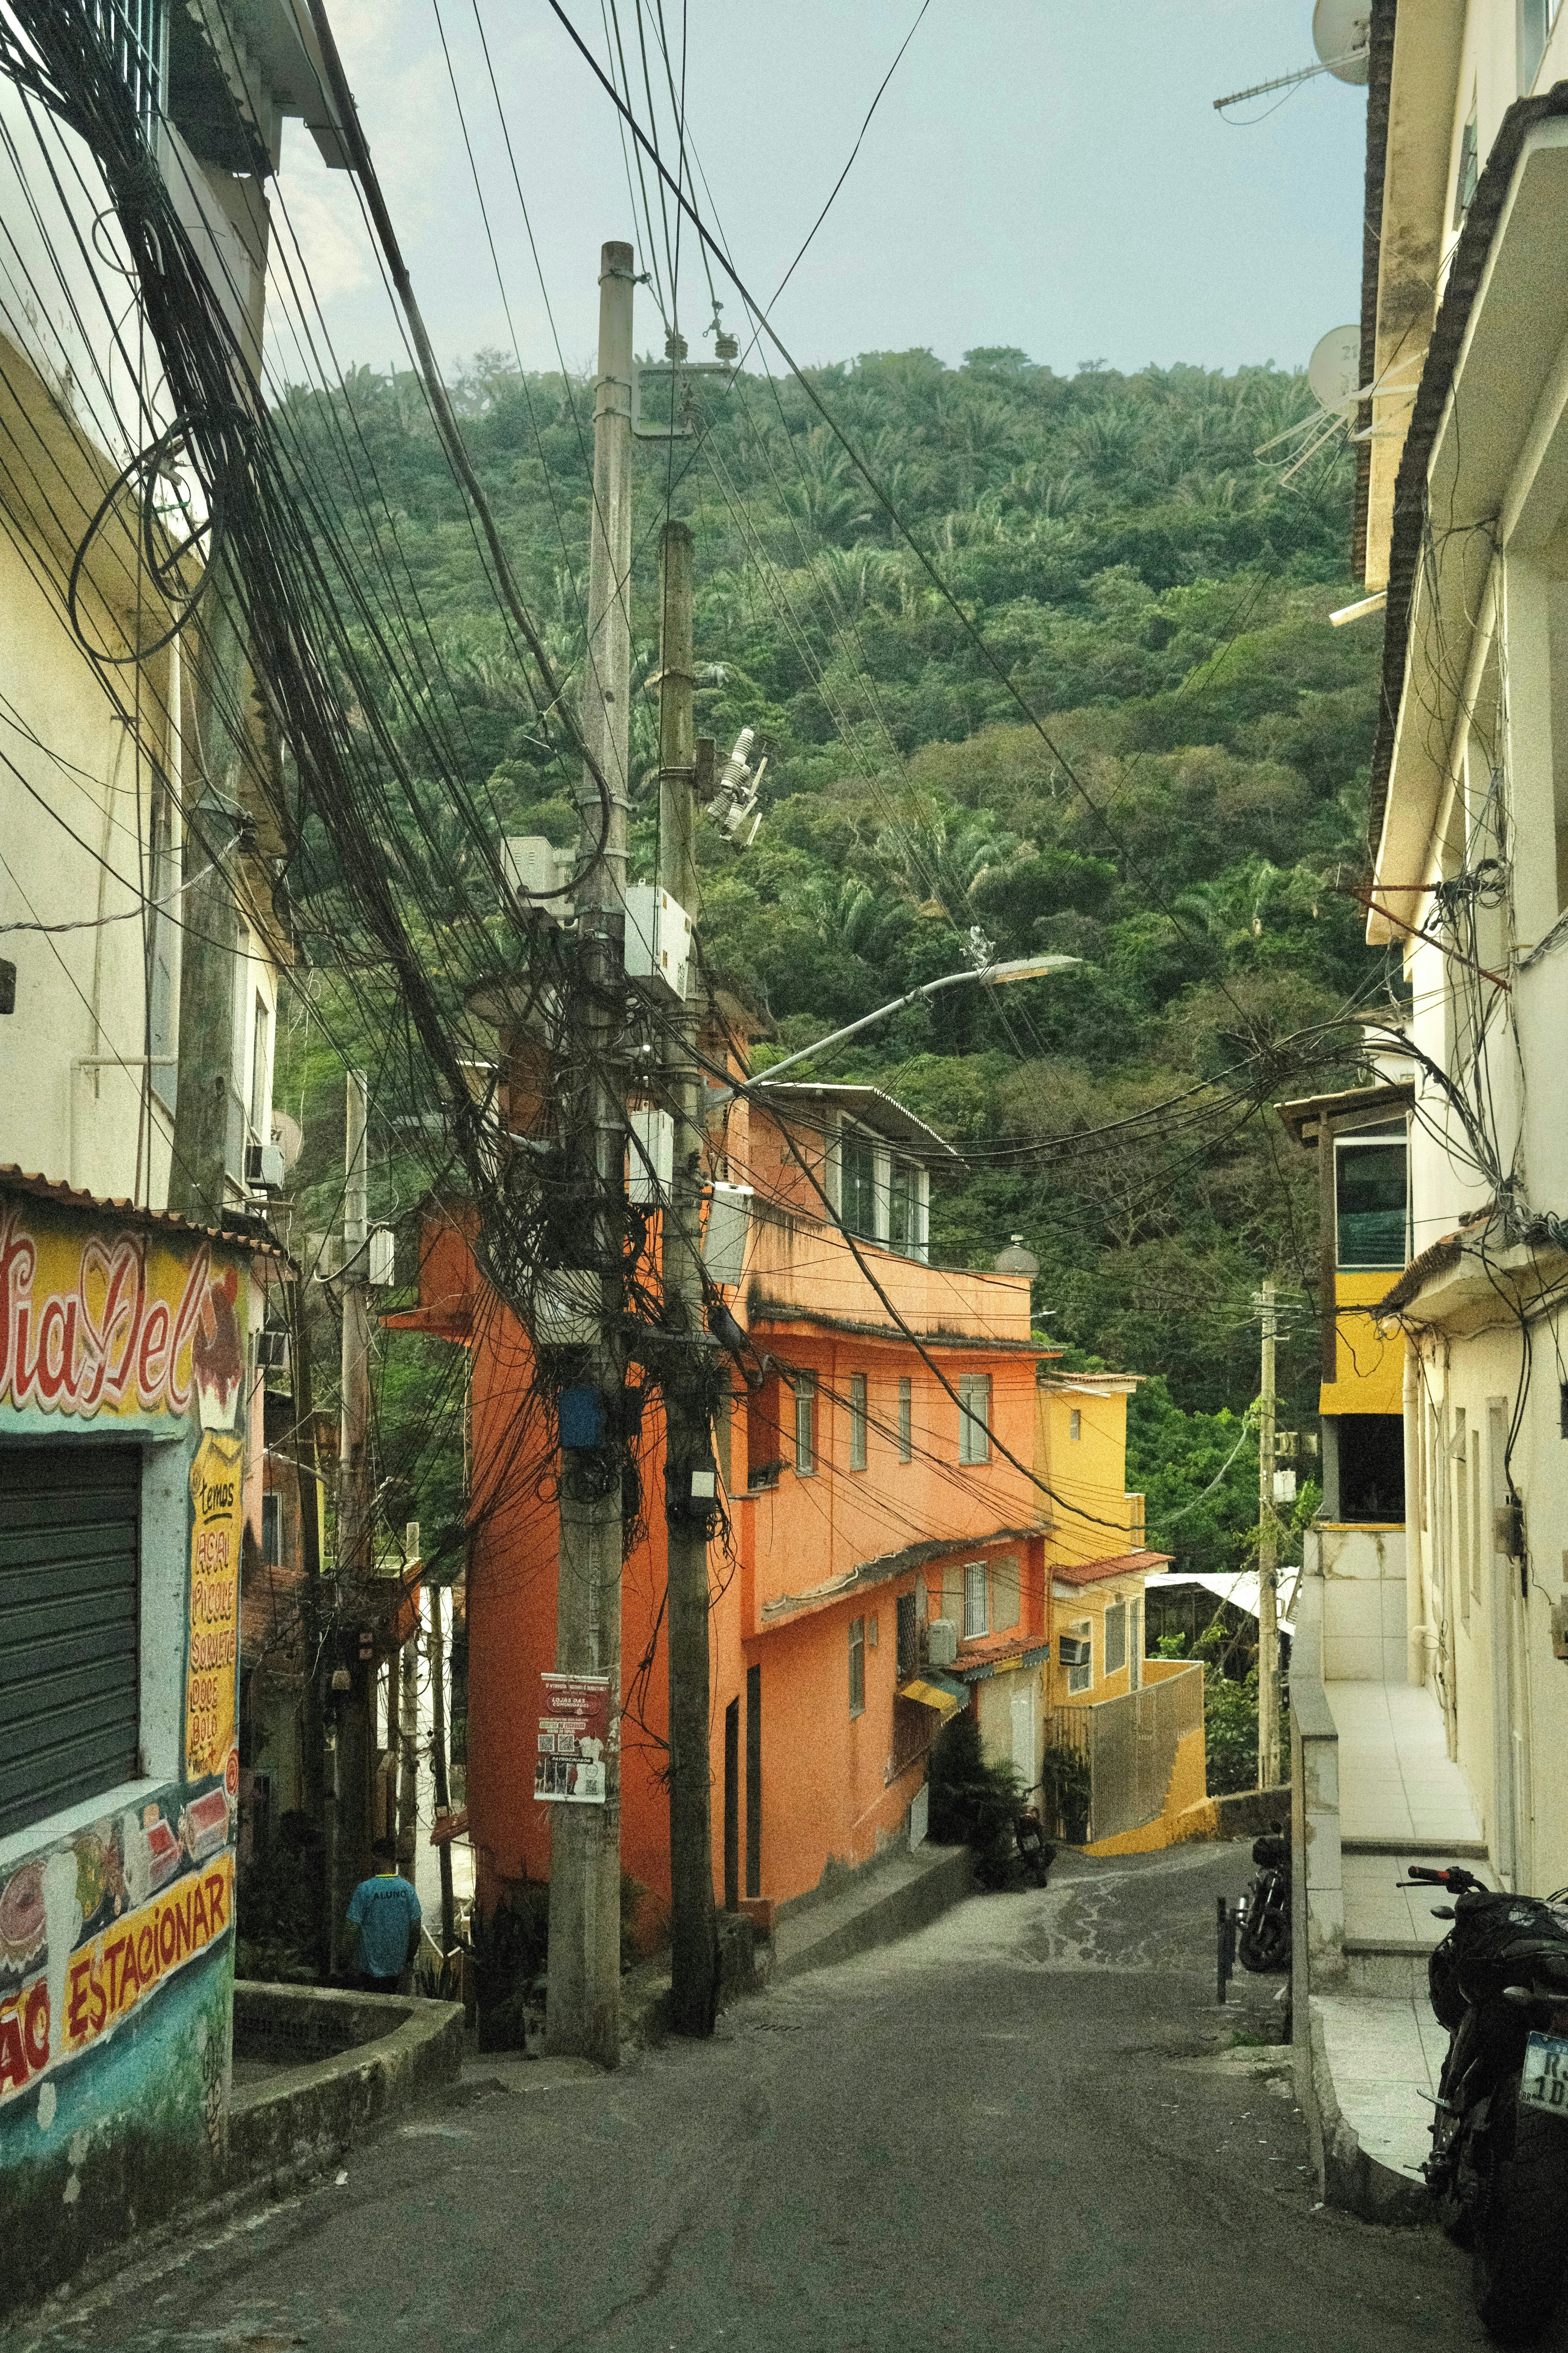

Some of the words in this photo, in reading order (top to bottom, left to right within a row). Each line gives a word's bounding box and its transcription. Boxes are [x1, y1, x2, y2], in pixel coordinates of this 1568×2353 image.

[199, 1477, 234, 1515] temos
[191, 1629, 236, 1669] SORVETE
[191, 1677, 218, 1707] DOCE
[192, 1714, 218, 1746] BOLO
[374, 1890, 407, 1900] ALUNO
[1532, 2075, 1568, 2106] 1D
